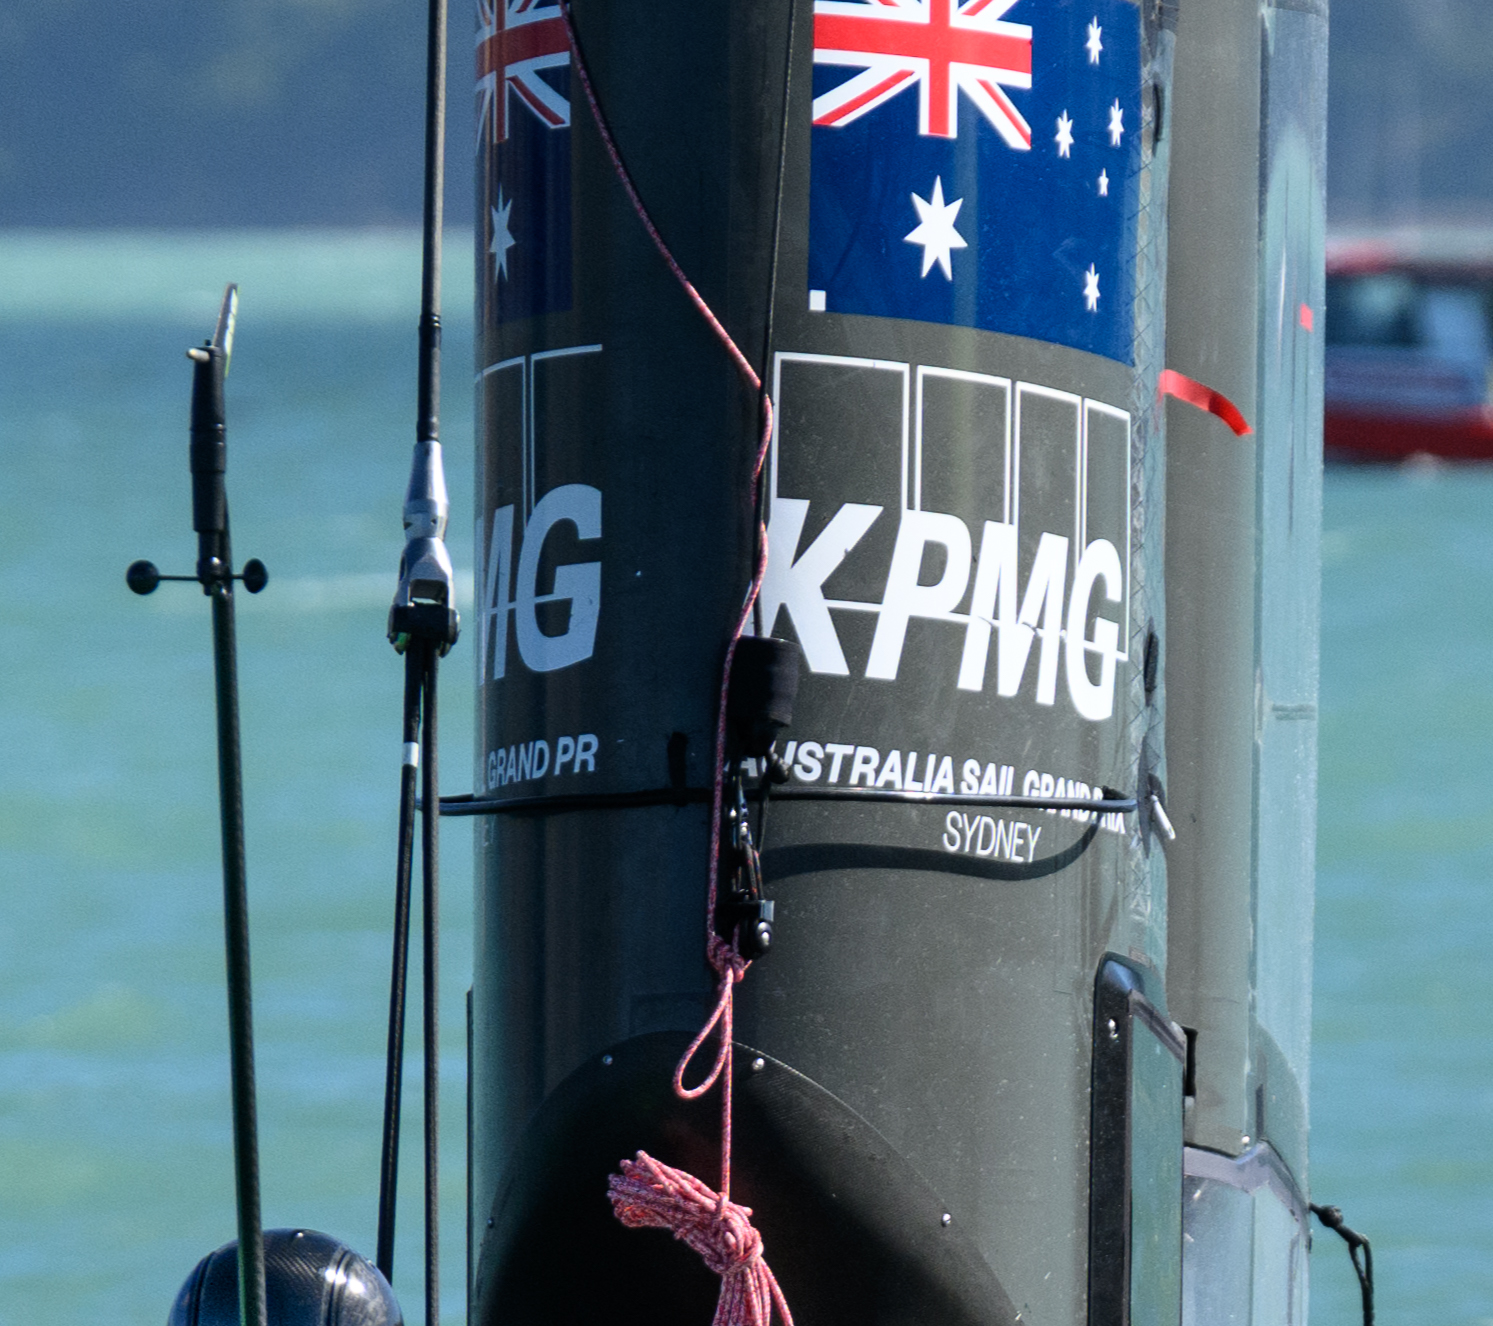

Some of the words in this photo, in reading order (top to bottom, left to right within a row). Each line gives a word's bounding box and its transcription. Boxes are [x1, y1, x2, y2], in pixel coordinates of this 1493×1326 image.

[741, 497, 1122, 721] KPMG
[487, 739, 550, 790] GRAND
[942, 809, 1042, 863] SYDNEY
